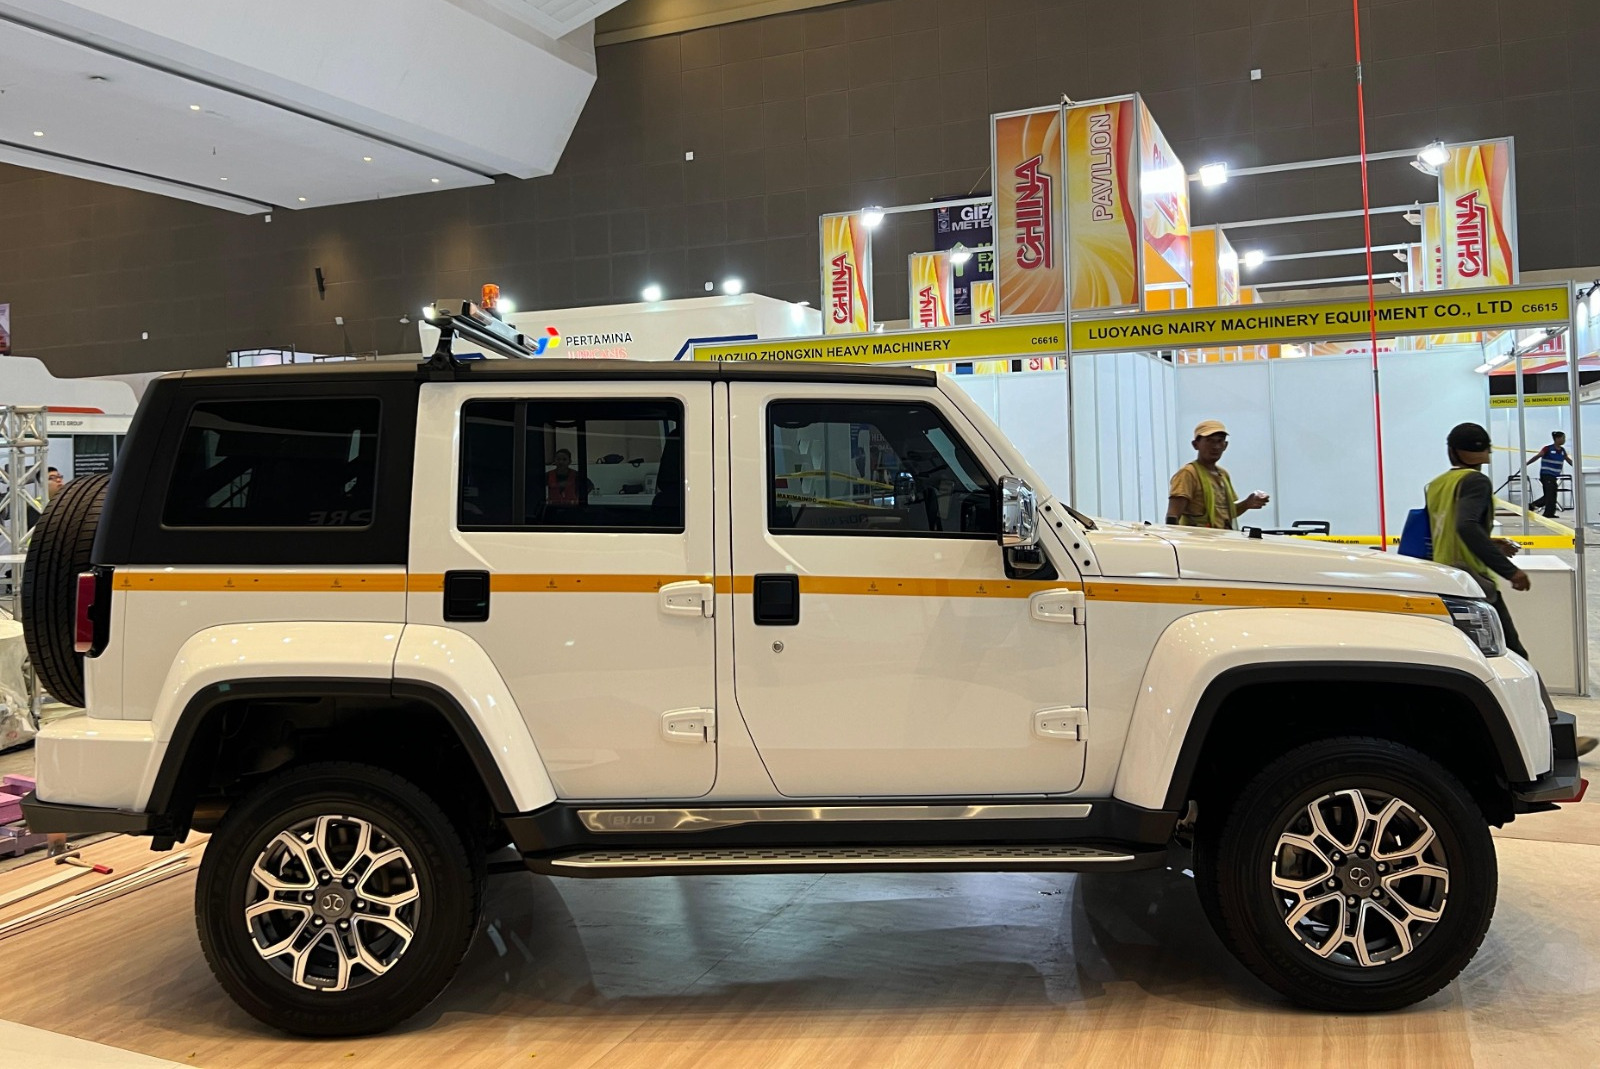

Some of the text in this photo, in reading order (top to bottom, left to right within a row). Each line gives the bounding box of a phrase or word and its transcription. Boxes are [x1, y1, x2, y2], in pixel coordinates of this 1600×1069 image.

[1090, 113, 1113, 221] PAVILION
[1015, 154, 1053, 269] CHINA
[1456, 190, 1489, 278] CHINA
[832, 252, 853, 324] CHINA
[919, 285, 938, 328] HINA
[566, 332, 633, 346] PERTAMINA
[1089, 300, 1558, 340] LUOYANG NAIRY MACHINERY EQUIPMENT CO., LTD C6615
[761, 348, 823, 361] ZHONGXIN
[827, 344, 869, 357] HEAVY
[872, 339, 951, 354] MACHINERY
[1031, 336, 1058, 345] C6616
[613, 815, 656, 826] BJ40
